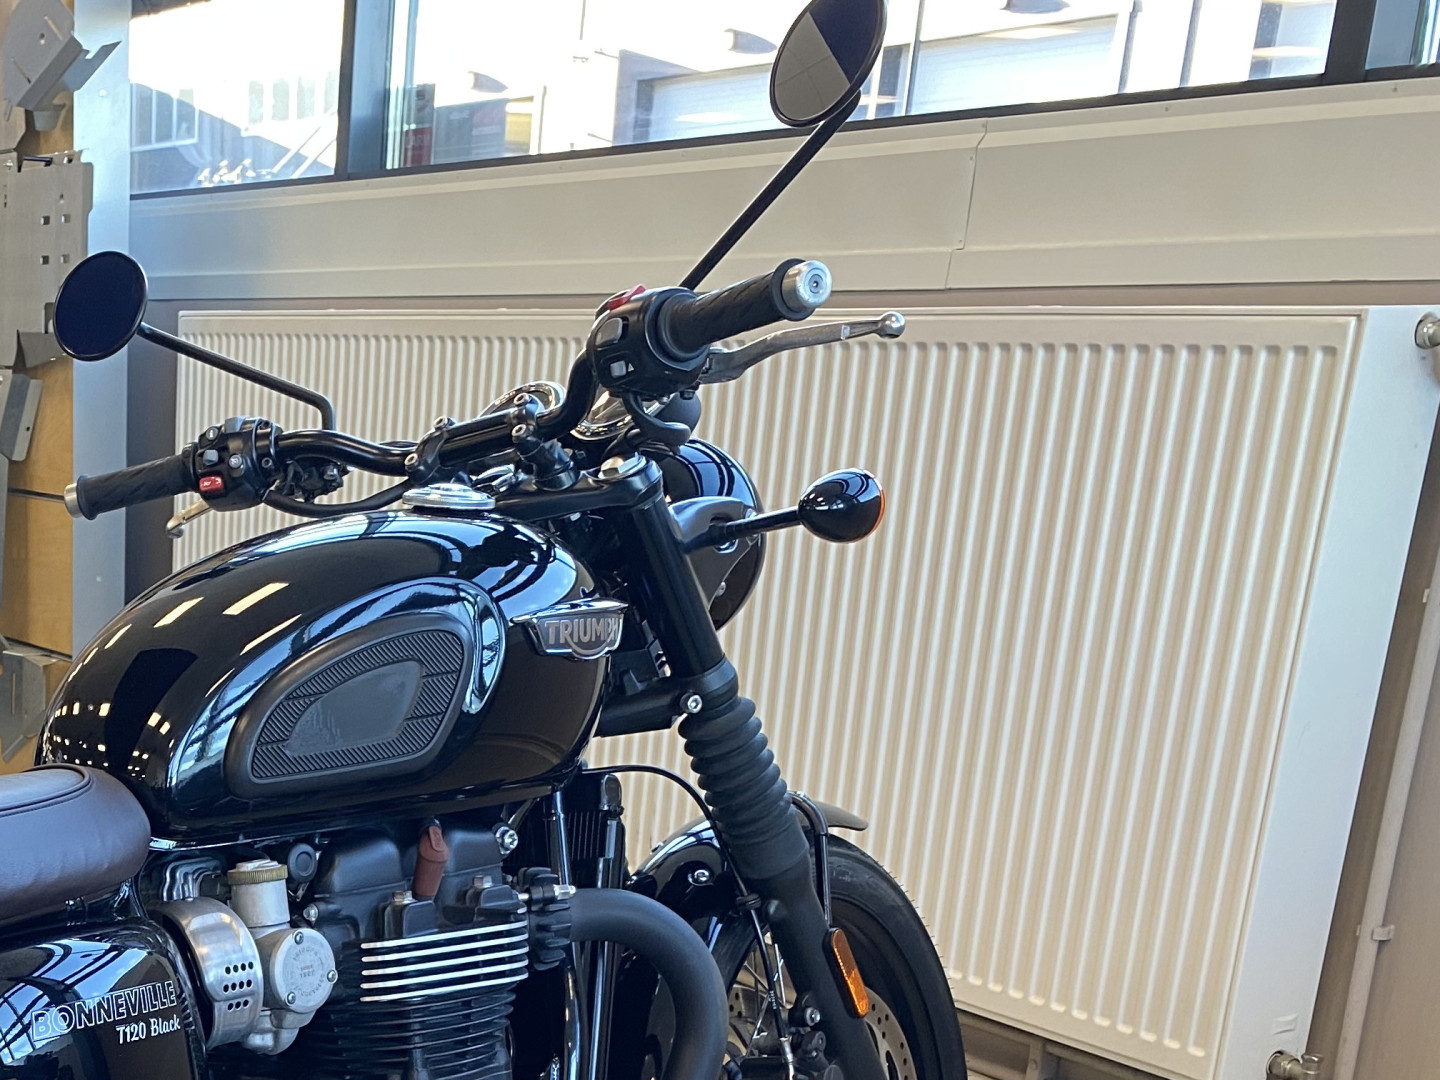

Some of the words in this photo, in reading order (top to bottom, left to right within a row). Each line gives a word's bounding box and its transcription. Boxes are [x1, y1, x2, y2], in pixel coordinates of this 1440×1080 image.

[545, 617, 620, 655] TRIUMPH
[32, 980, 178, 1041] BONNEVILLE
[116, 1020, 146, 1045] T120
[150, 1014, 181, 1037] Black
